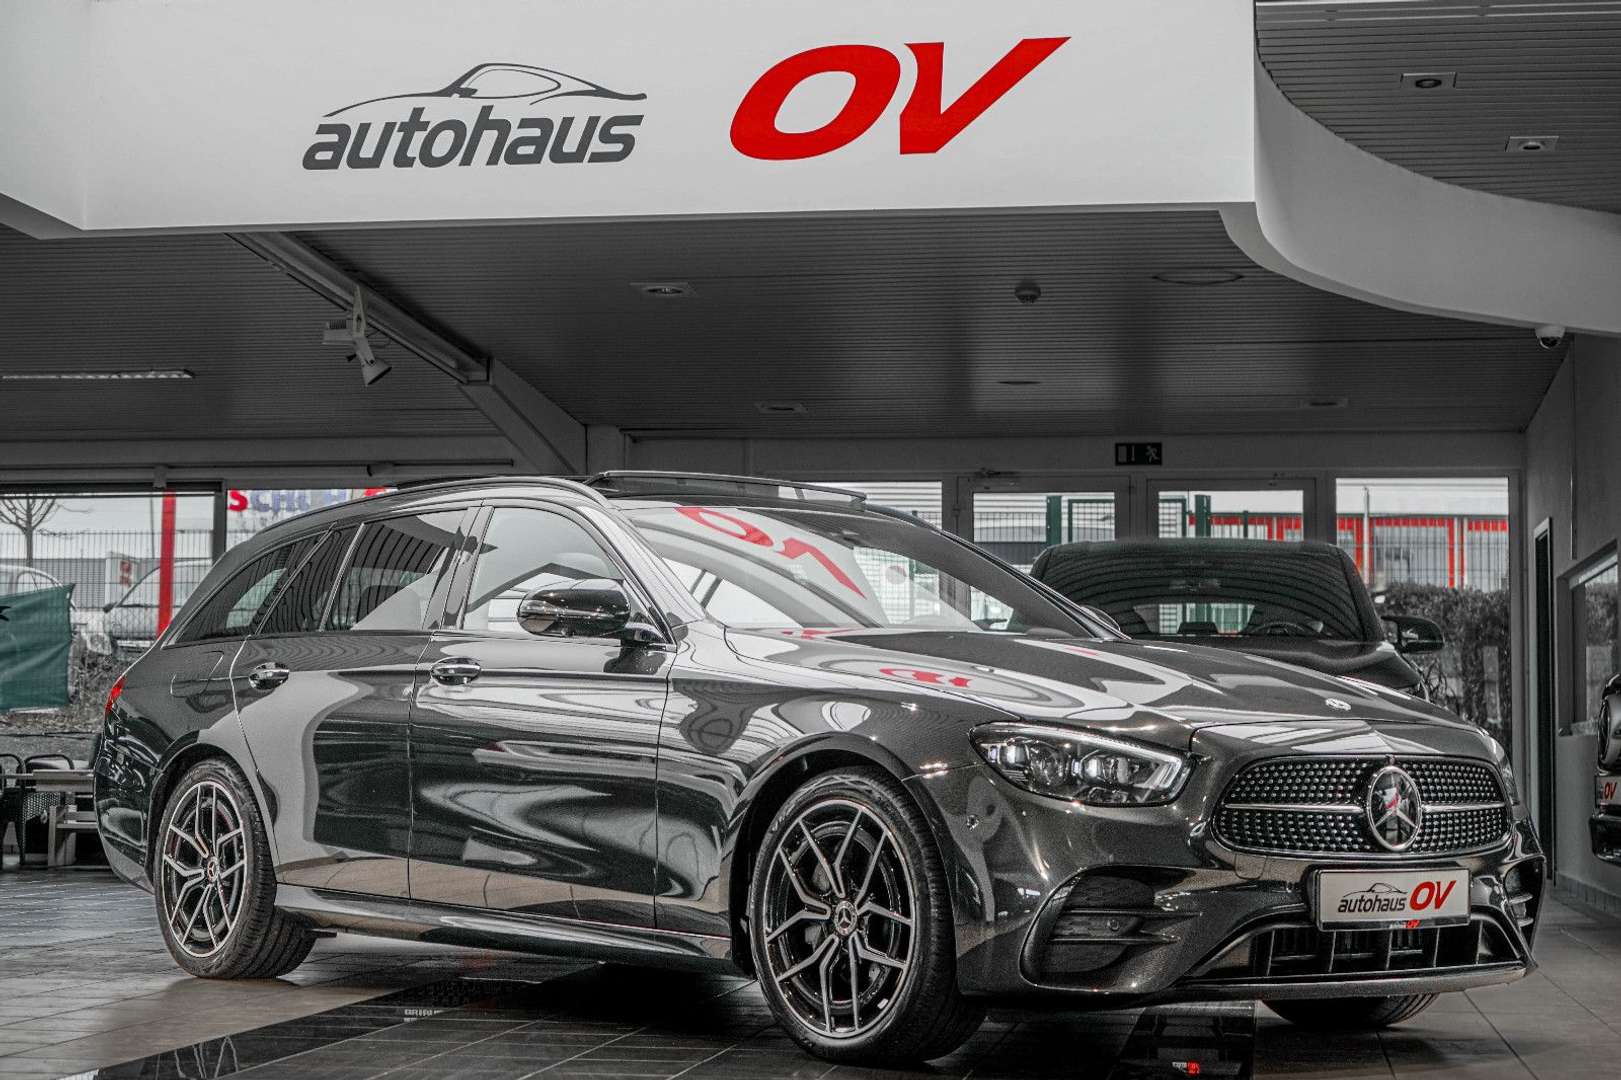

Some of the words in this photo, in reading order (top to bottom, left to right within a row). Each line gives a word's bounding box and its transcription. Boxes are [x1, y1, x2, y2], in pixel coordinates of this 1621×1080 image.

[301, 105, 645, 170] autohaus
[729, 36, 1072, 161] OV
[1604, 781, 1618, 801] OV
[1337, 894, 1407, 914] autohaus
[1409, 880, 1457, 912] OV
